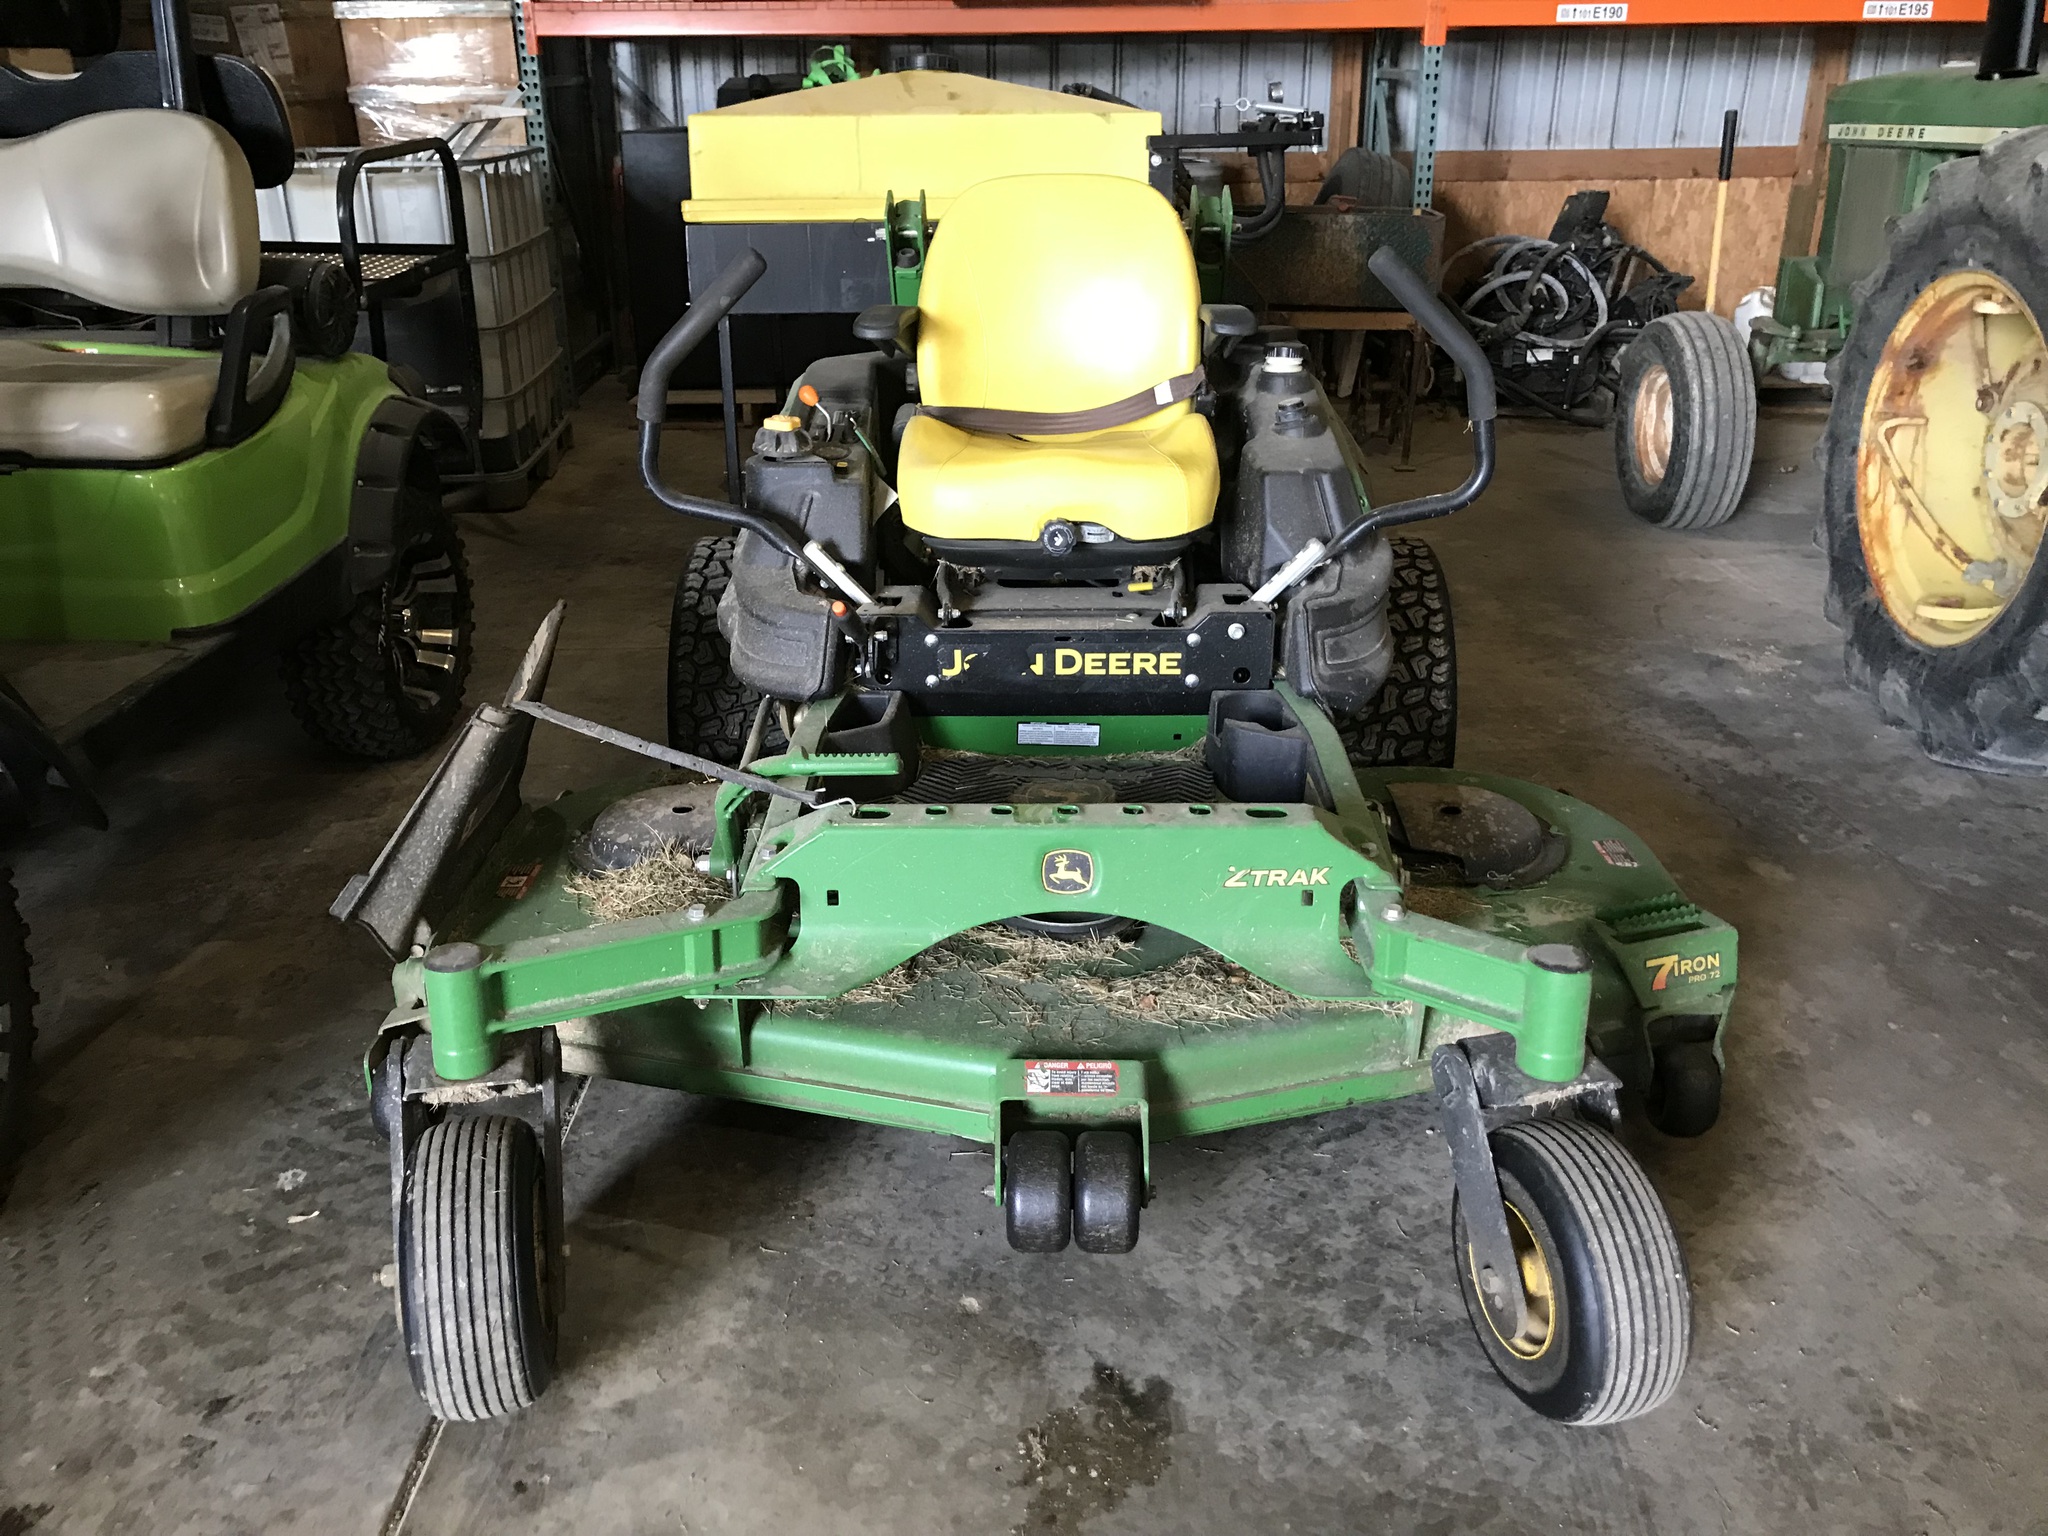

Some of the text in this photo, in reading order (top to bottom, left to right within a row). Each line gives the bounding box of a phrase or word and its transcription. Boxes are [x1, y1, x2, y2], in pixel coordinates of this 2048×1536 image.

[1593, 6, 1623, 19] E190
[1899, 3, 1929, 15] E195
[1837, 126, 1926, 139] JOHN DEERE
[1055, 648, 1182, 675] DEERE
[1224, 865, 1332, 888] ZTRAK
[1688, 970, 1721, 984] PRO 72
